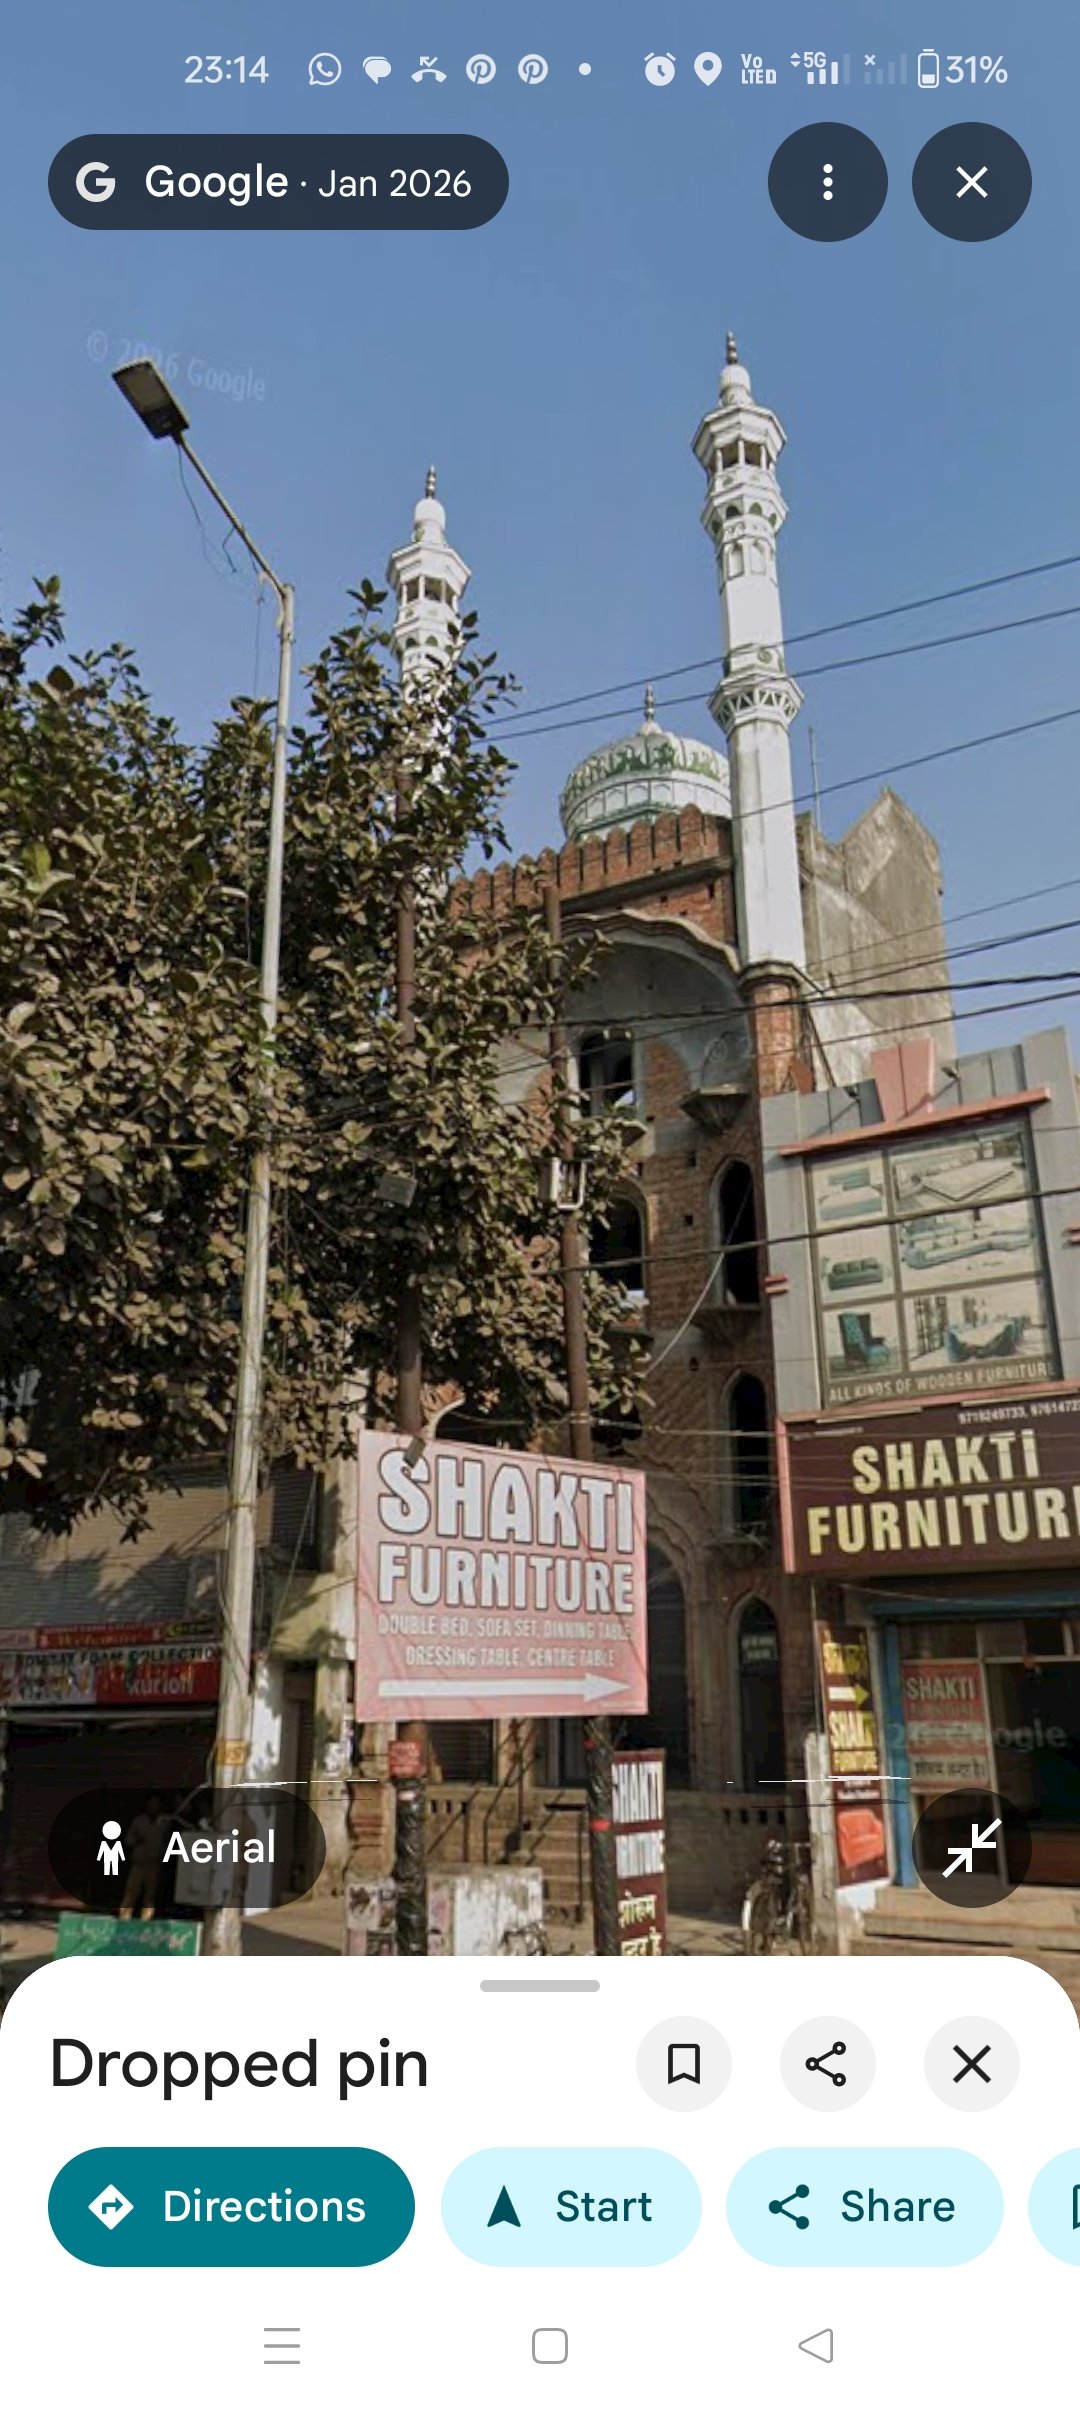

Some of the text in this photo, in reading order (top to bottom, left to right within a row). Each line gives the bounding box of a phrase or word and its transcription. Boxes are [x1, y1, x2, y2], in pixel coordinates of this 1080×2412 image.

[829, 1359, 1056, 1403] ALL KINDS OF WOODEN FURNITURE
[852, 1429, 1040, 1494] SHAKTI
[378, 1448, 635, 1554] SHAKTI
[378, 1541, 635, 1614] FURNITURE
[378, 1613, 436, 1635] DOUBLE
[476, 1617, 511, 1637] SOFA
[544, 1620, 594, 1640] DINNING
[406, 1646, 475, 1666] DRESSING
[527, 1648, 574, 1668] CENTRE
[579, 1649, 614, 1668] TABLE
[905, 1677, 975, 1701] SHAKTI
